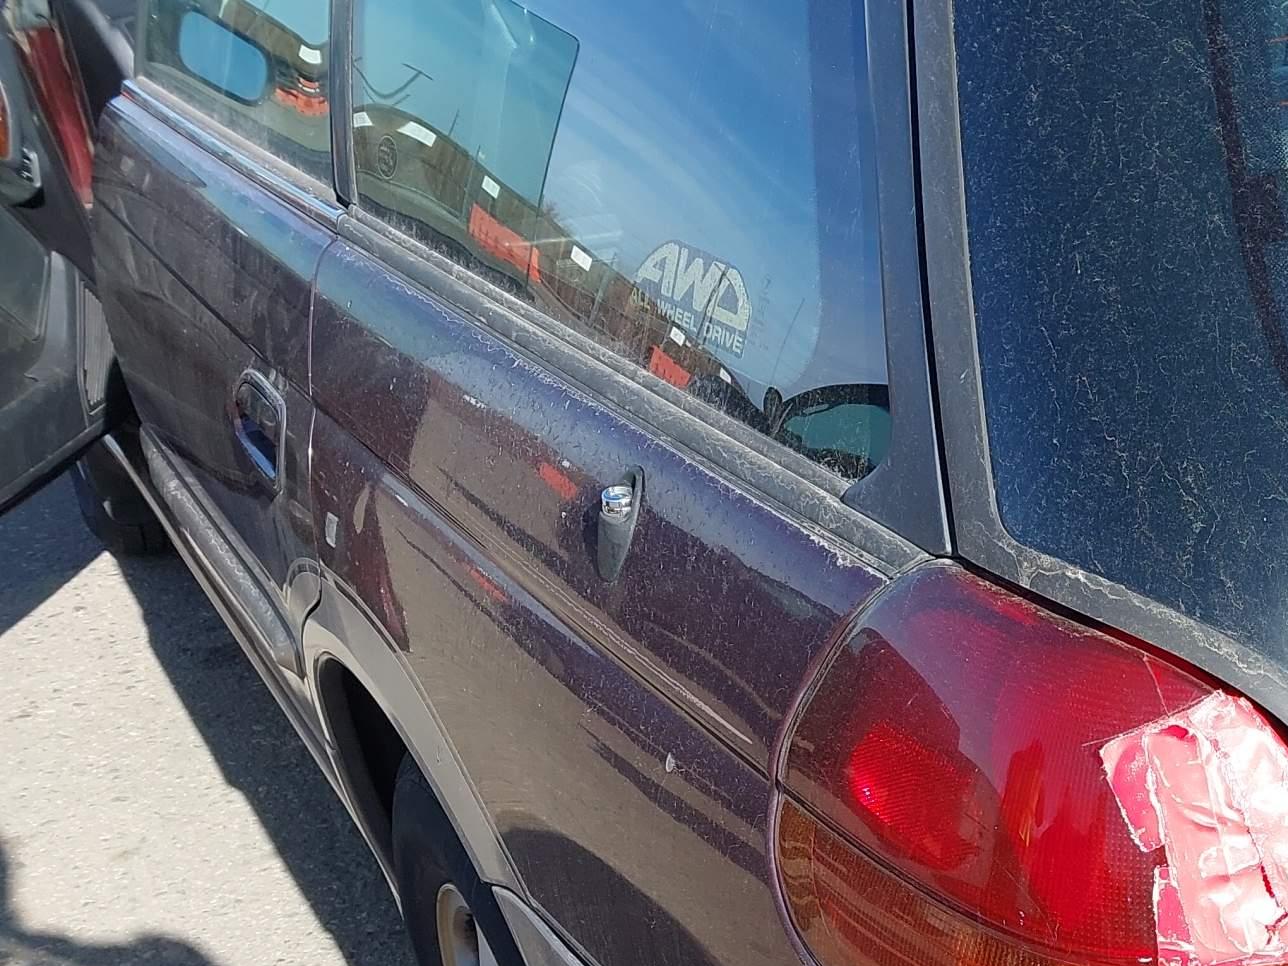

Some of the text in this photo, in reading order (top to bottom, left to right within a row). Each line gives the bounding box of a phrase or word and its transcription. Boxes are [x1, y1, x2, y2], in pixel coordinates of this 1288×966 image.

[630, 286, 744, 355] ALL WHEEL DRIVE
[636, 241, 750, 331] AWD
